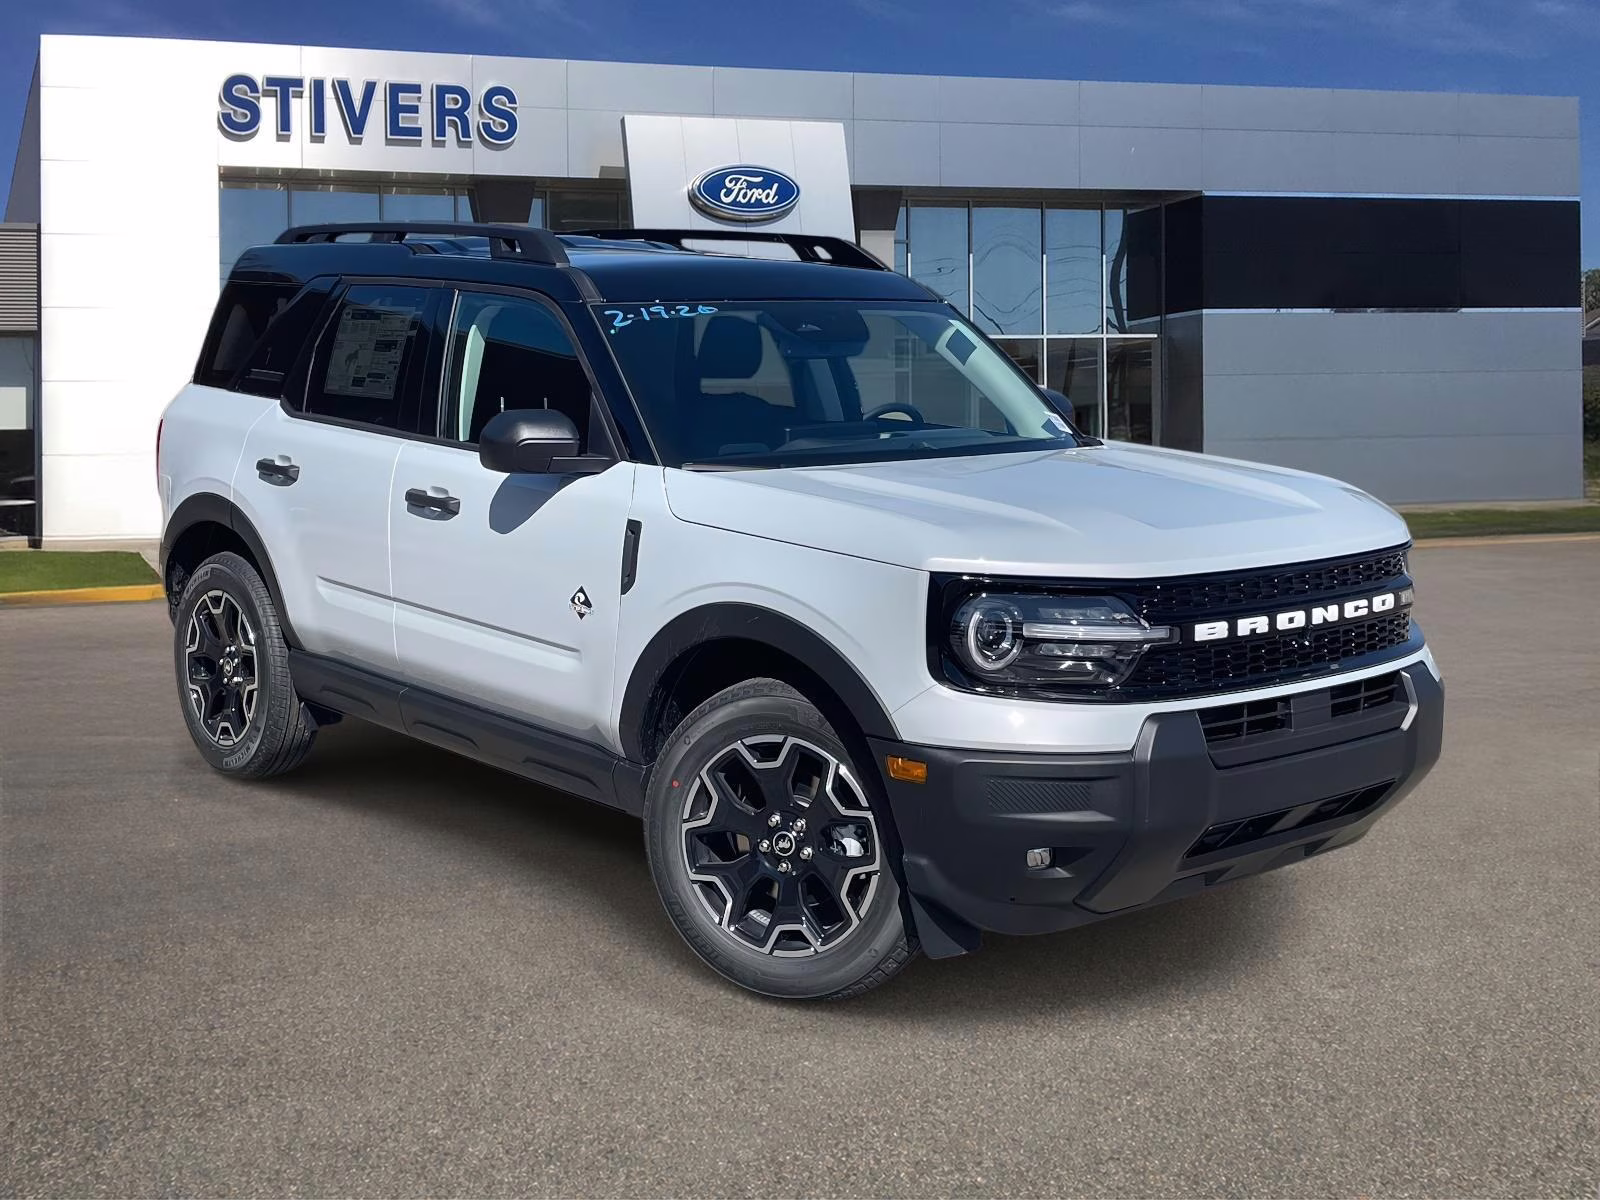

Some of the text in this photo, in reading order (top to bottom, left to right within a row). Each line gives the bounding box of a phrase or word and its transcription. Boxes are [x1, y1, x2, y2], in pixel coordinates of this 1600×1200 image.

[218, 73, 519, 150] STIVERS
[720, 174, 779, 204] Ford
[1194, 592, 1395, 642] BRONCO
